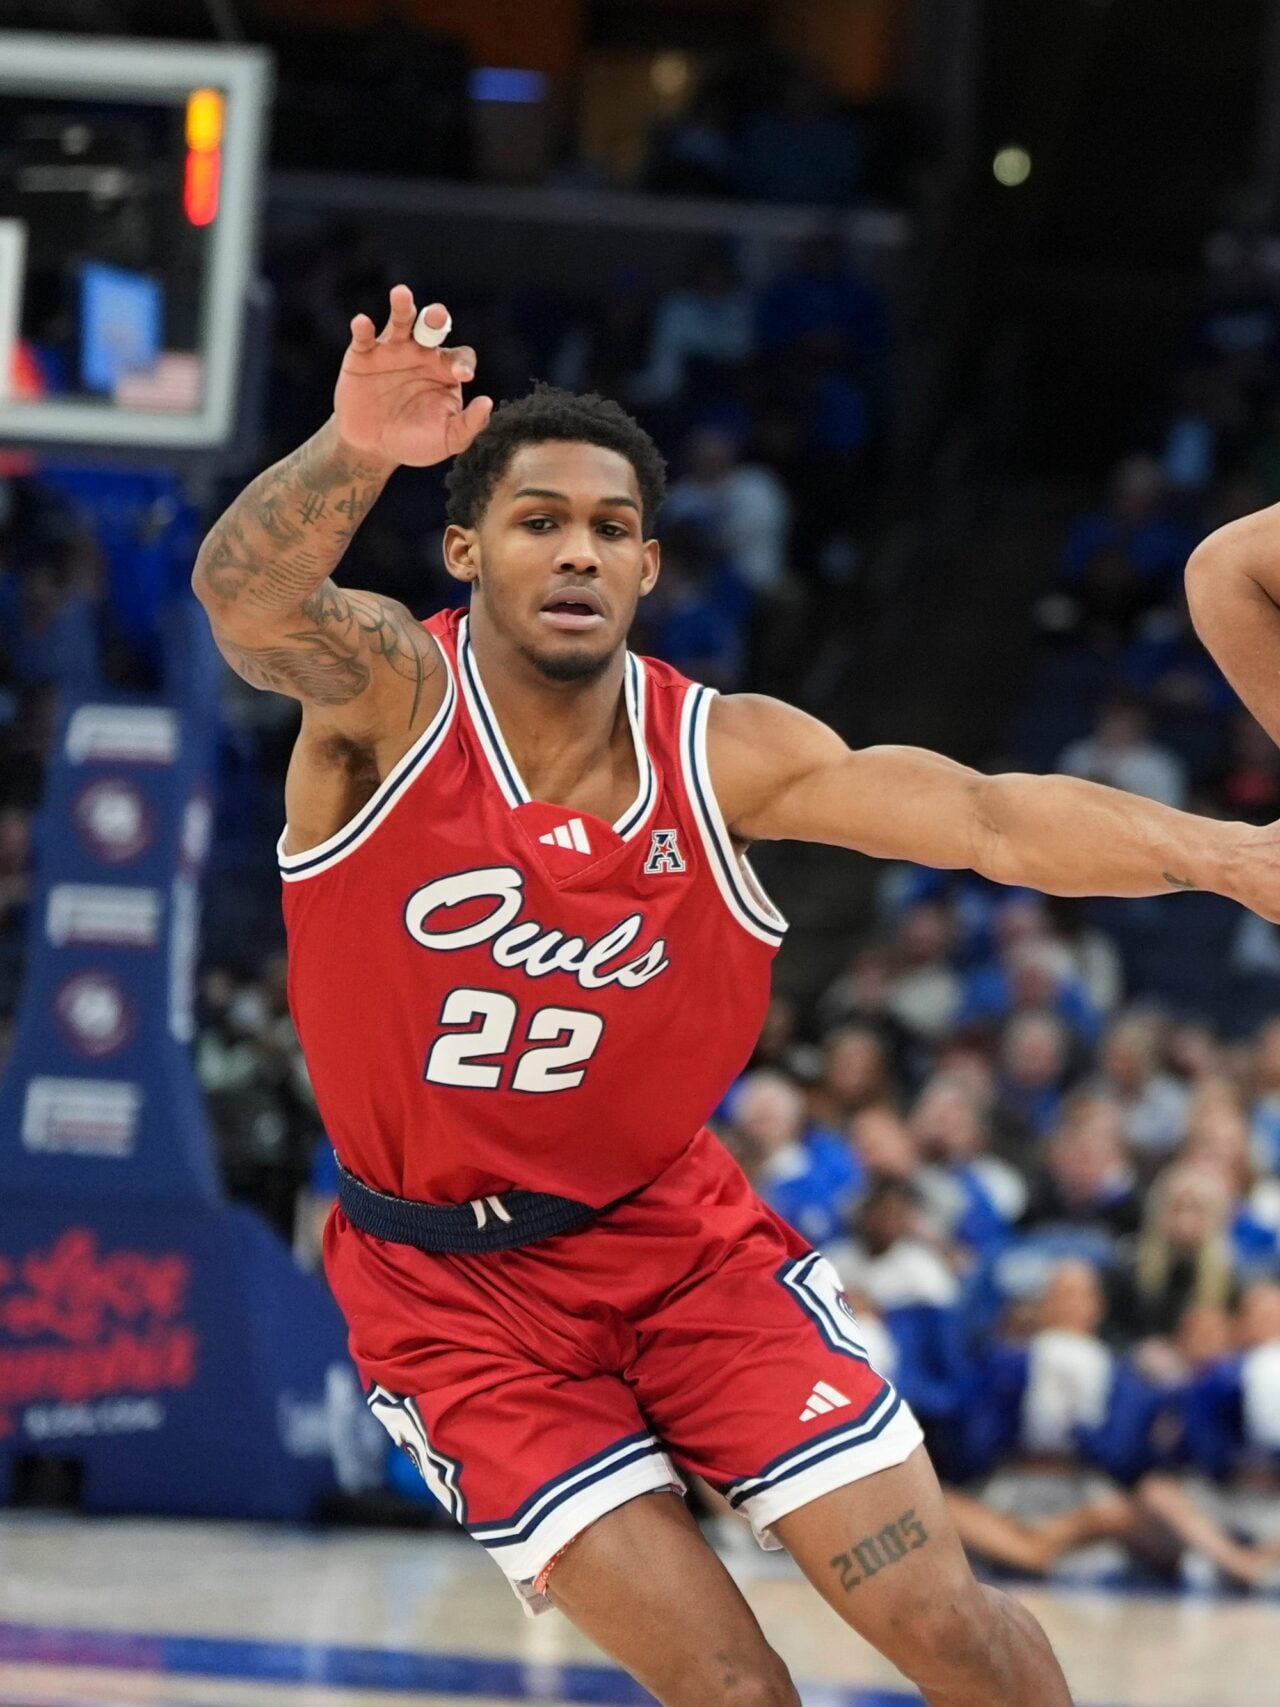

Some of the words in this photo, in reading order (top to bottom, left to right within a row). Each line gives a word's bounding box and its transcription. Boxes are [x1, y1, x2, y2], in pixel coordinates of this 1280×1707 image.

[404, 865, 670, 989] Owls
[424, 986, 606, 1093] 22
[829, 1508, 928, 1593] 2005
